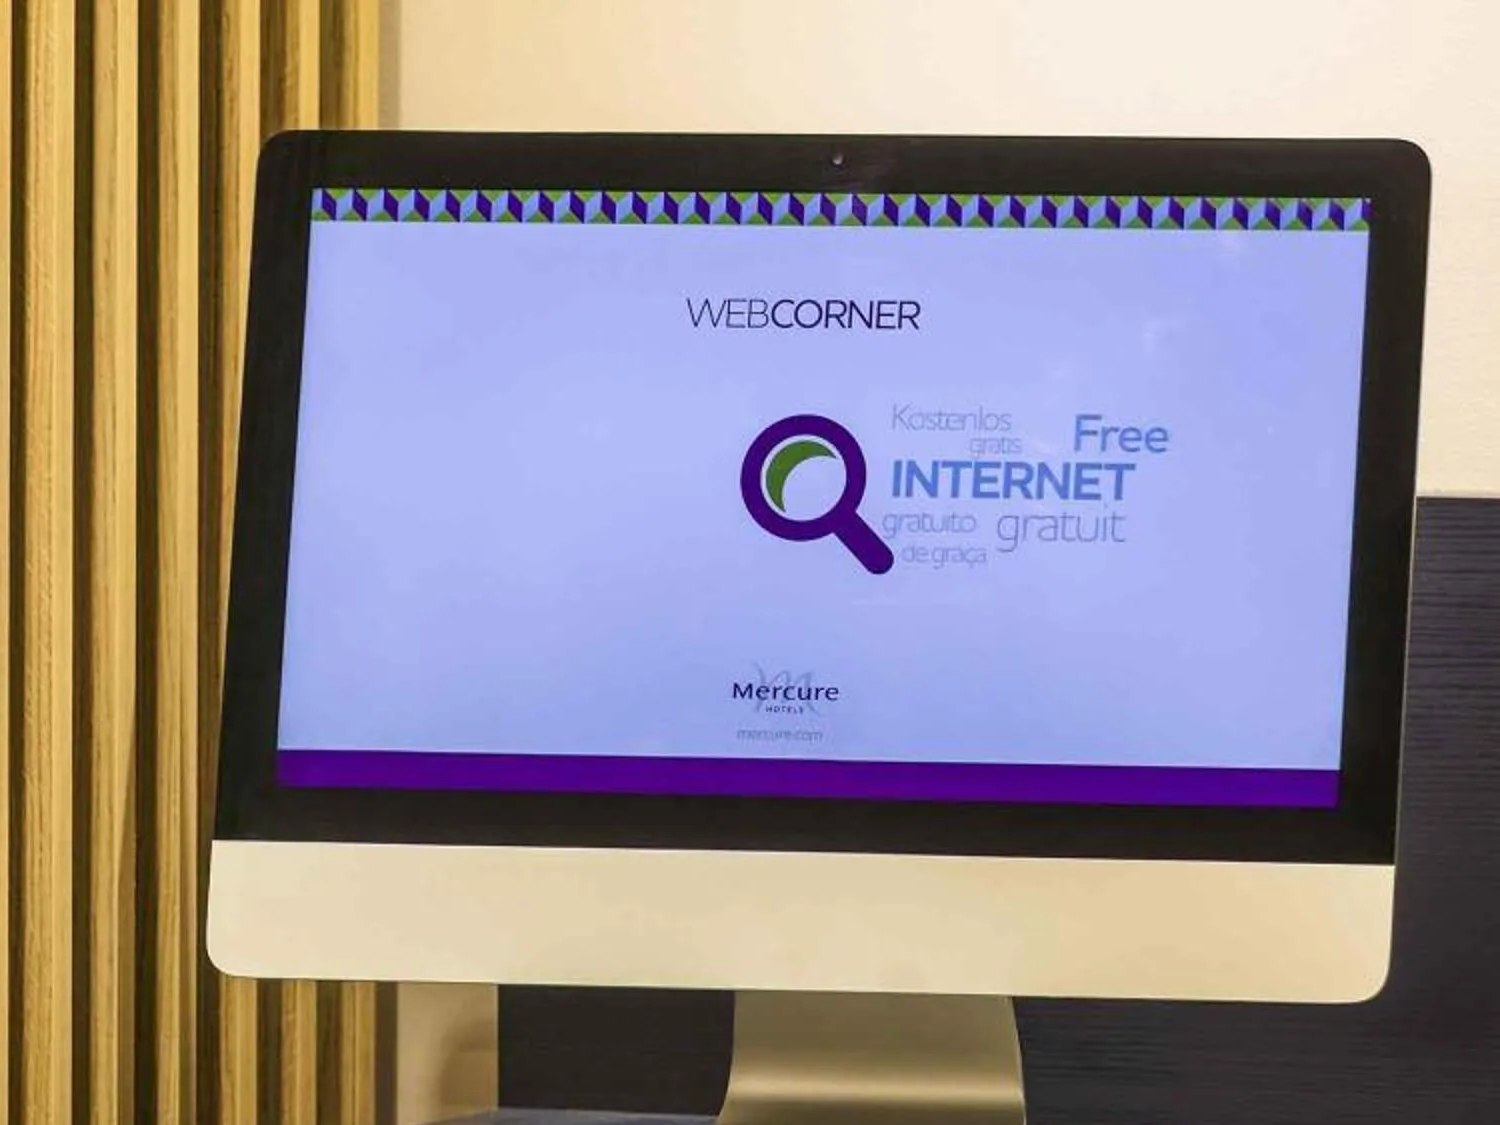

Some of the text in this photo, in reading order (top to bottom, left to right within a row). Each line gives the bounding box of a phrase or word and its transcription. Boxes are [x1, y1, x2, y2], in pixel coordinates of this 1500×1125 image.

[686, 298, 922, 330] WEBCORNER
[891, 404, 1012, 433] Kostenlos
[969, 436, 1023, 457] gratis
[1073, 414, 1170, 454] Free
[891, 460, 1136, 501] INTERNET
[883, 511, 977, 540] gratuito
[996, 506, 1126, 553] gratuit
[902, 544, 987, 570] de graça
[732, 682, 840, 701] Mercure
[765, 705, 804, 715] HOTELS
